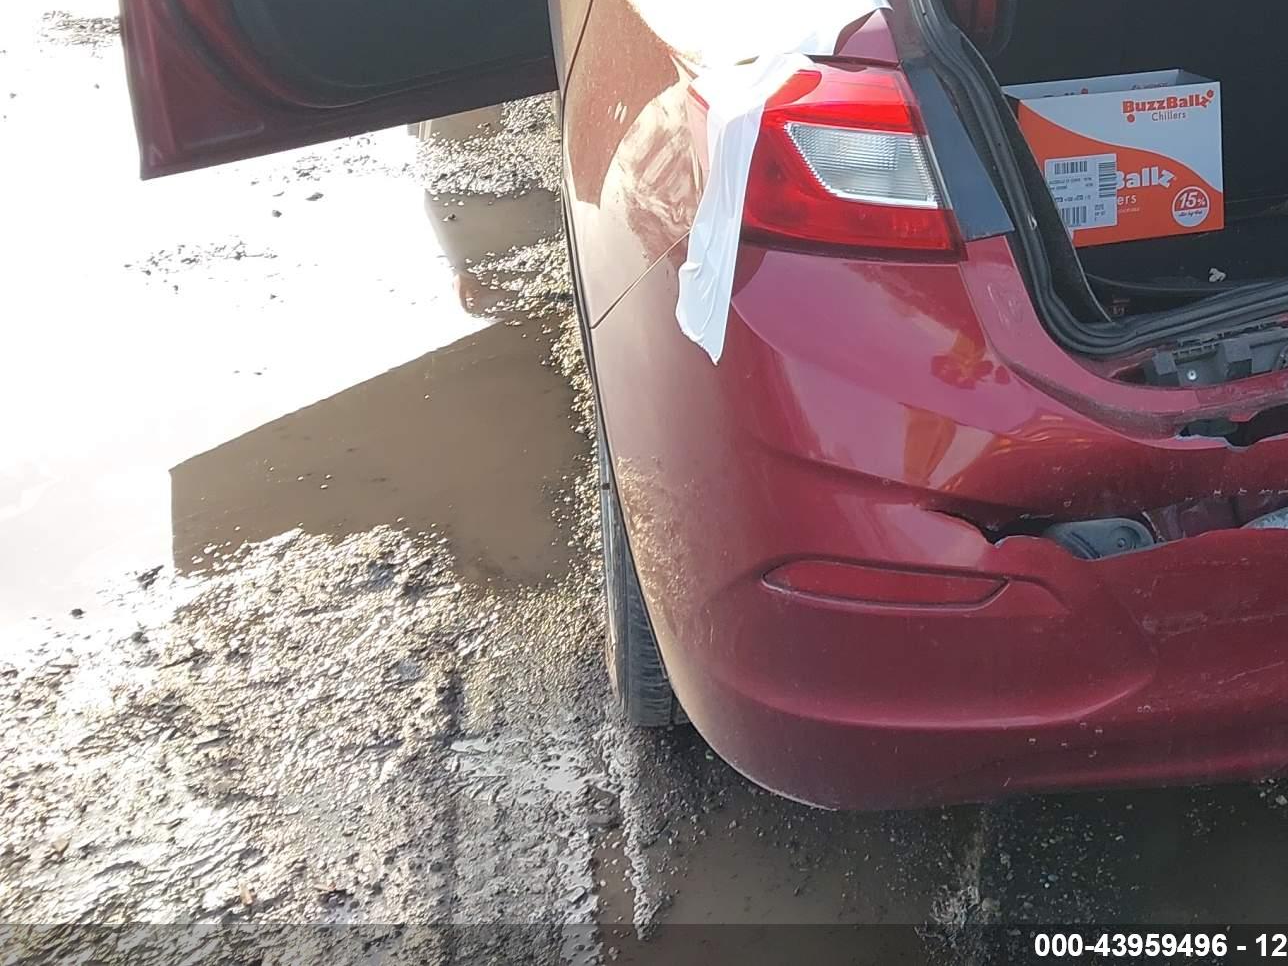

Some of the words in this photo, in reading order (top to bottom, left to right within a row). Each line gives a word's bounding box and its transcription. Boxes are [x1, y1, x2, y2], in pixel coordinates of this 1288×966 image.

[1123, 93, 1213, 114] BuzzBallz
[1151, 110, 1187, 122] Chillers
[1177, 191, 1206, 209] 15%
